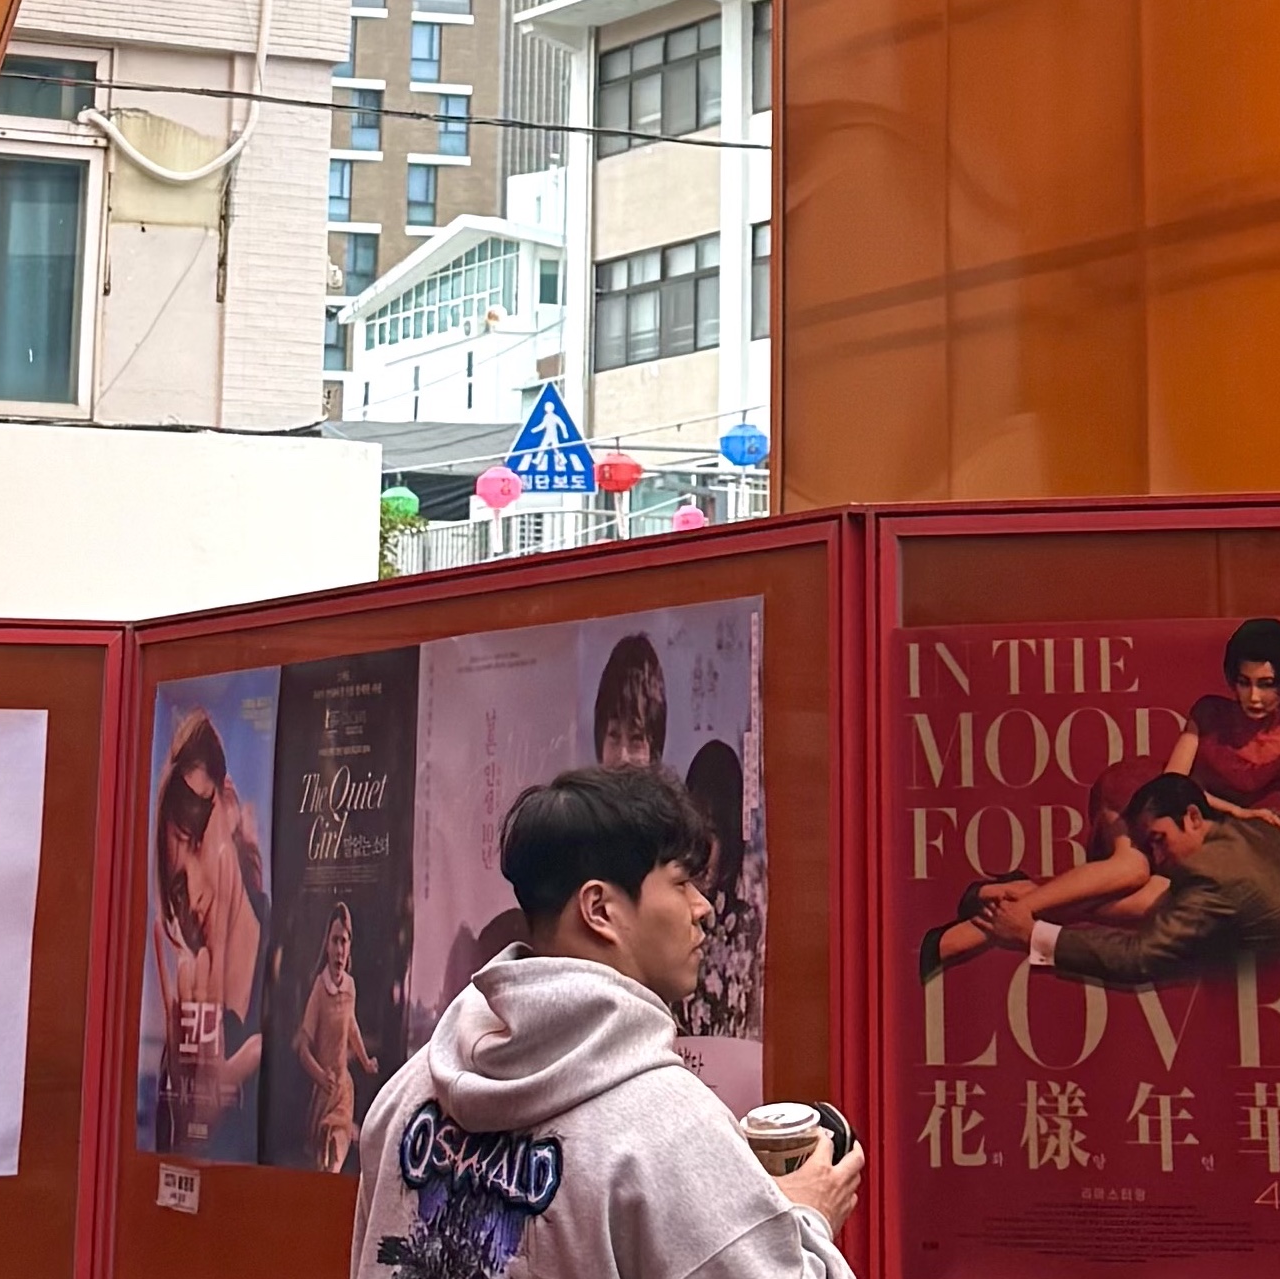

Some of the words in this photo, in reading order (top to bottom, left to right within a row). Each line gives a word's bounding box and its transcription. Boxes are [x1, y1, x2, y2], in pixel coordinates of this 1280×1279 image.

[905, 641, 974, 699] IN
[992, 636, 1139, 695] THE
[300, 773, 329, 814] The
[328, 765, 388, 822] Quiet
[308, 811, 349, 861] Girl
[906, 805, 1087, 881] FOR
[402, 1105, 559, 1208] OSWALD
